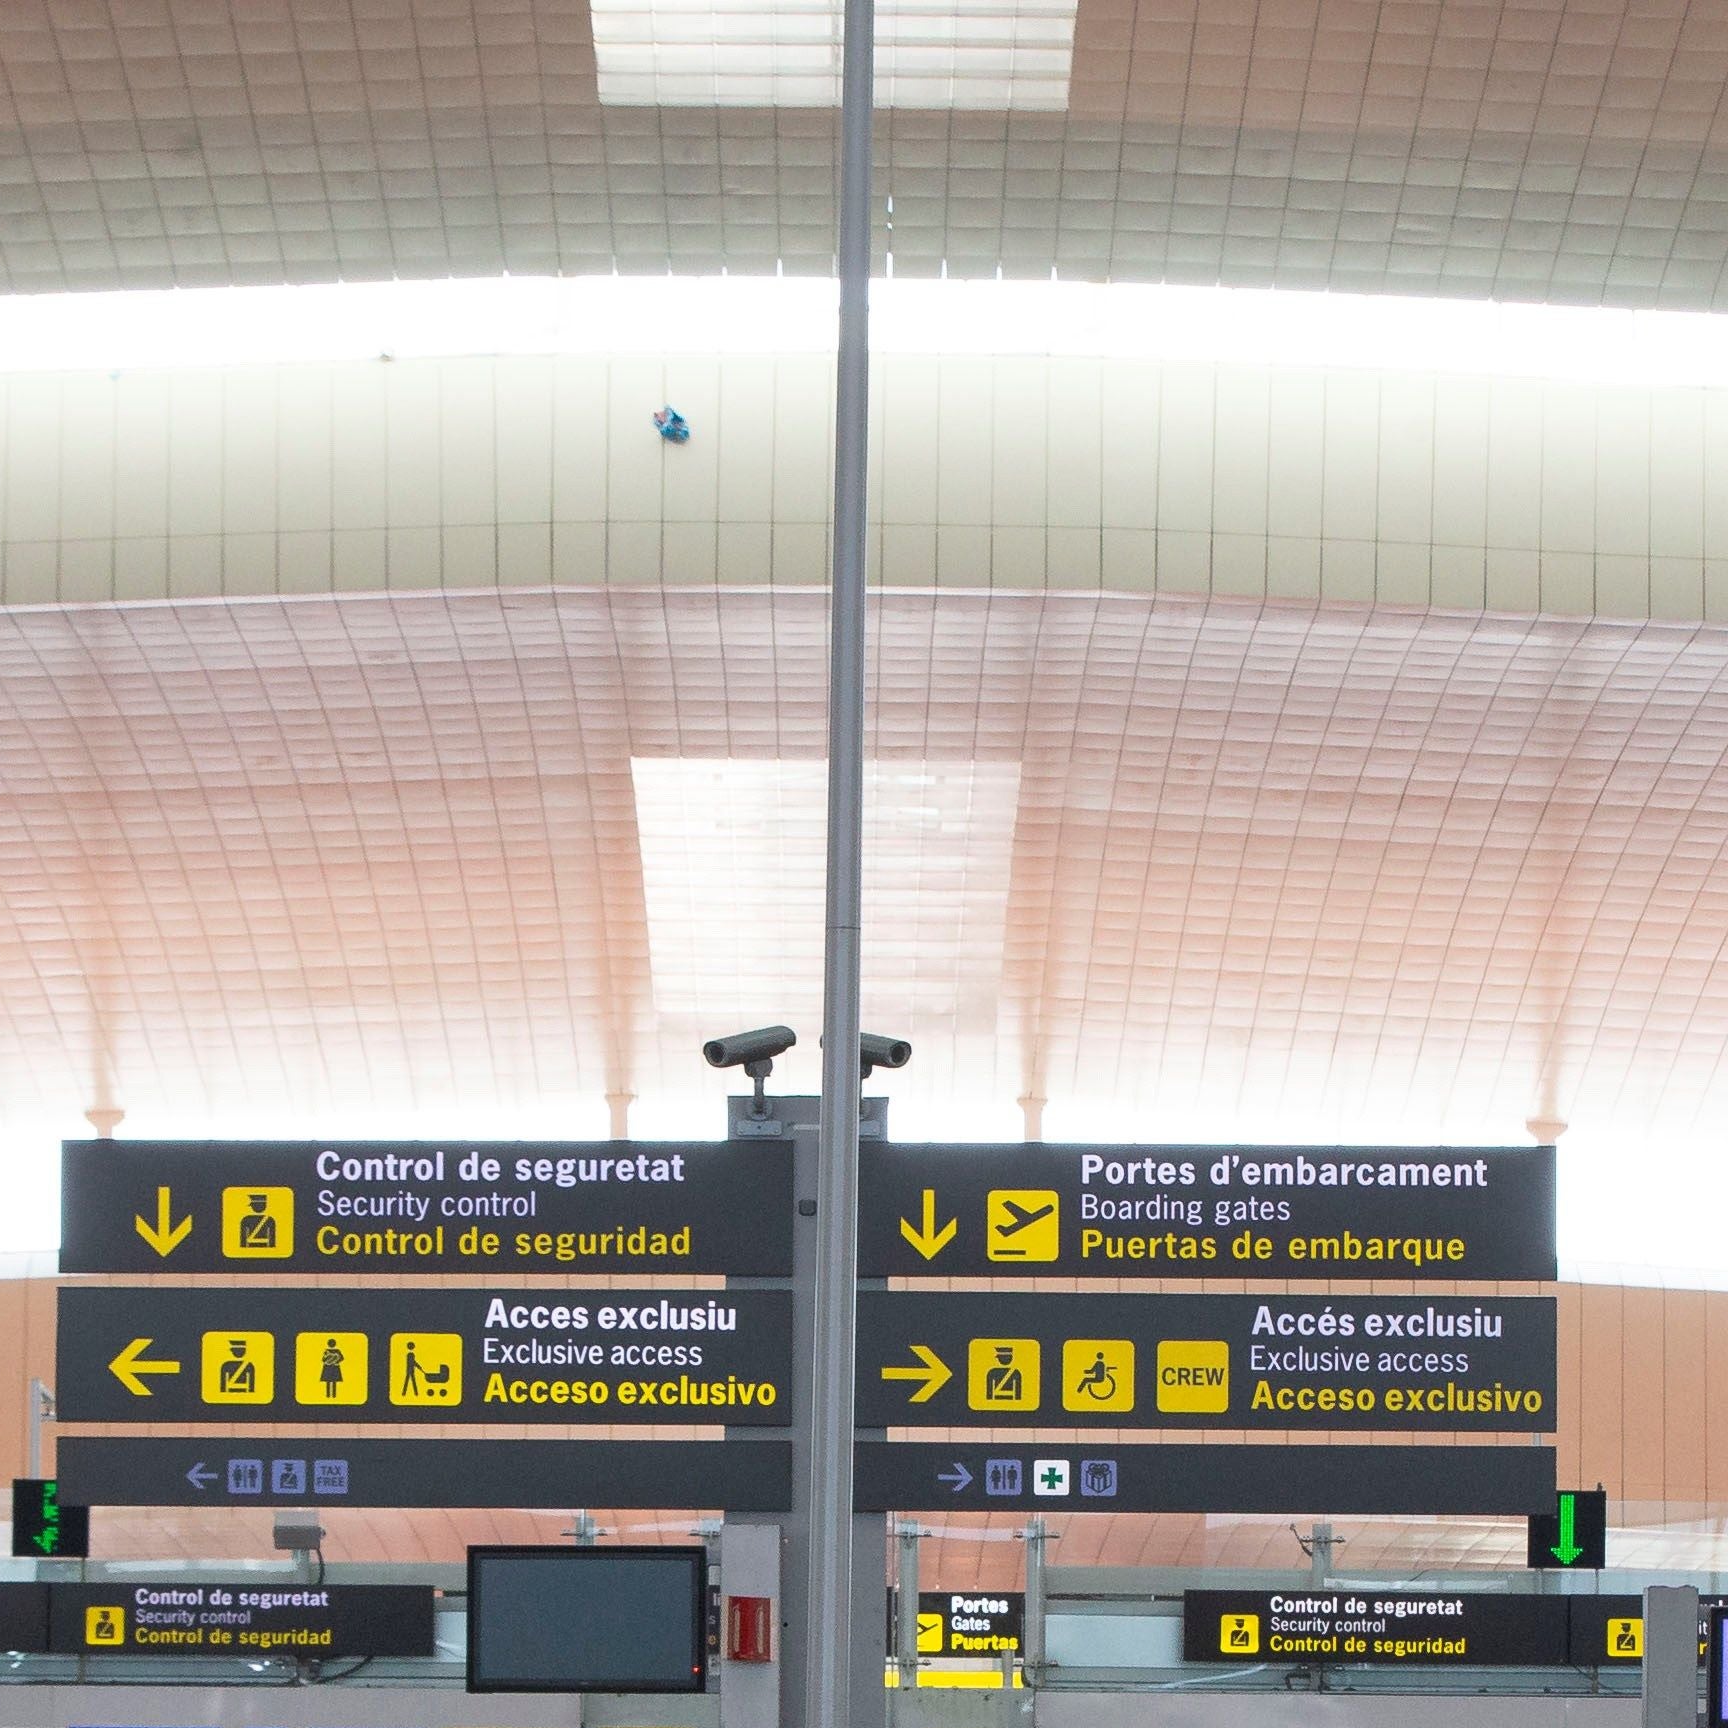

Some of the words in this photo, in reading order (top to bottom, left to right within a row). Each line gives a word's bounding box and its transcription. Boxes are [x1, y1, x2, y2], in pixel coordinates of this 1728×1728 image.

[317, 1151, 443, 1180] Control
[459, 1152, 500, 1181] de
[516, 1155, 684, 1187] seguretat
[1082, 1155, 1195, 1184] Portes
[1210, 1156, 1487, 1186] d'embarcament
[318, 1190, 429, 1221] Security
[441, 1191, 535, 1216] control
[1082, 1194, 1202, 1225] Boarding
[1215, 1197, 1290, 1225] gates
[317, 1226, 443, 1254] Control
[459, 1227, 499, 1254] de
[516, 1227, 689, 1260] seguridad
[1083, 1230, 1216, 1258] Puertas
[1232, 1231, 1272, 1259] de
[1289, 1231, 1464, 1266] embarque
[485, 1299, 588, 1329] Acces
[598, 1300, 736, 1330] exclusiu
[1252, 1306, 1354, 1336] Accés
[1365, 1307, 1501, 1337] exclusiu
[484, 1338, 603, 1364] Exclusive
[611, 1346, 702, 1365] access
[1251, 1345, 1369, 1371] Exclusive
[1378, 1353, 1468, 1372] access
[1162, 1367, 1224, 1385] CREW
[484, 1373, 608, 1403] Acceso
[618, 1376, 776, 1405] exclusivo
[1251, 1381, 1375, 1410] Acceso
[1385, 1383, 1542, 1412] exclusivo
[318, 1477, 344, 1486] FREE
[320, 1466, 341, 1475] TAX
[135, 1588, 203, 1605] Control
[210, 1589, 232, 1605] de
[239, 1592, 328, 1609] seguretat
[952, 1596, 1008, 1613] Portes
[1270, 1596, 1337, 1613] Control
[1345, 1598, 1366, 1613] de
[1374, 1600, 1463, 1617] seguretat
[136, 1609, 195, 1628] Security
[200, 1610, 250, 1624] control
[952, 1616, 990, 1631] Gates
[1271, 1617, 1329, 1634] Security
[1335, 1619, 1385, 1632] control
[136, 1627, 202, 1643] Control
[209, 1629, 231, 1644] de
[239, 1629, 331, 1648] seguridad
[951, 1633, 1018, 1652] Puertas
[1270, 1635, 1336, 1651] Control
[1345, 1637, 1366, 1652] de
[1374, 1638, 1465, 1656] seguridad
